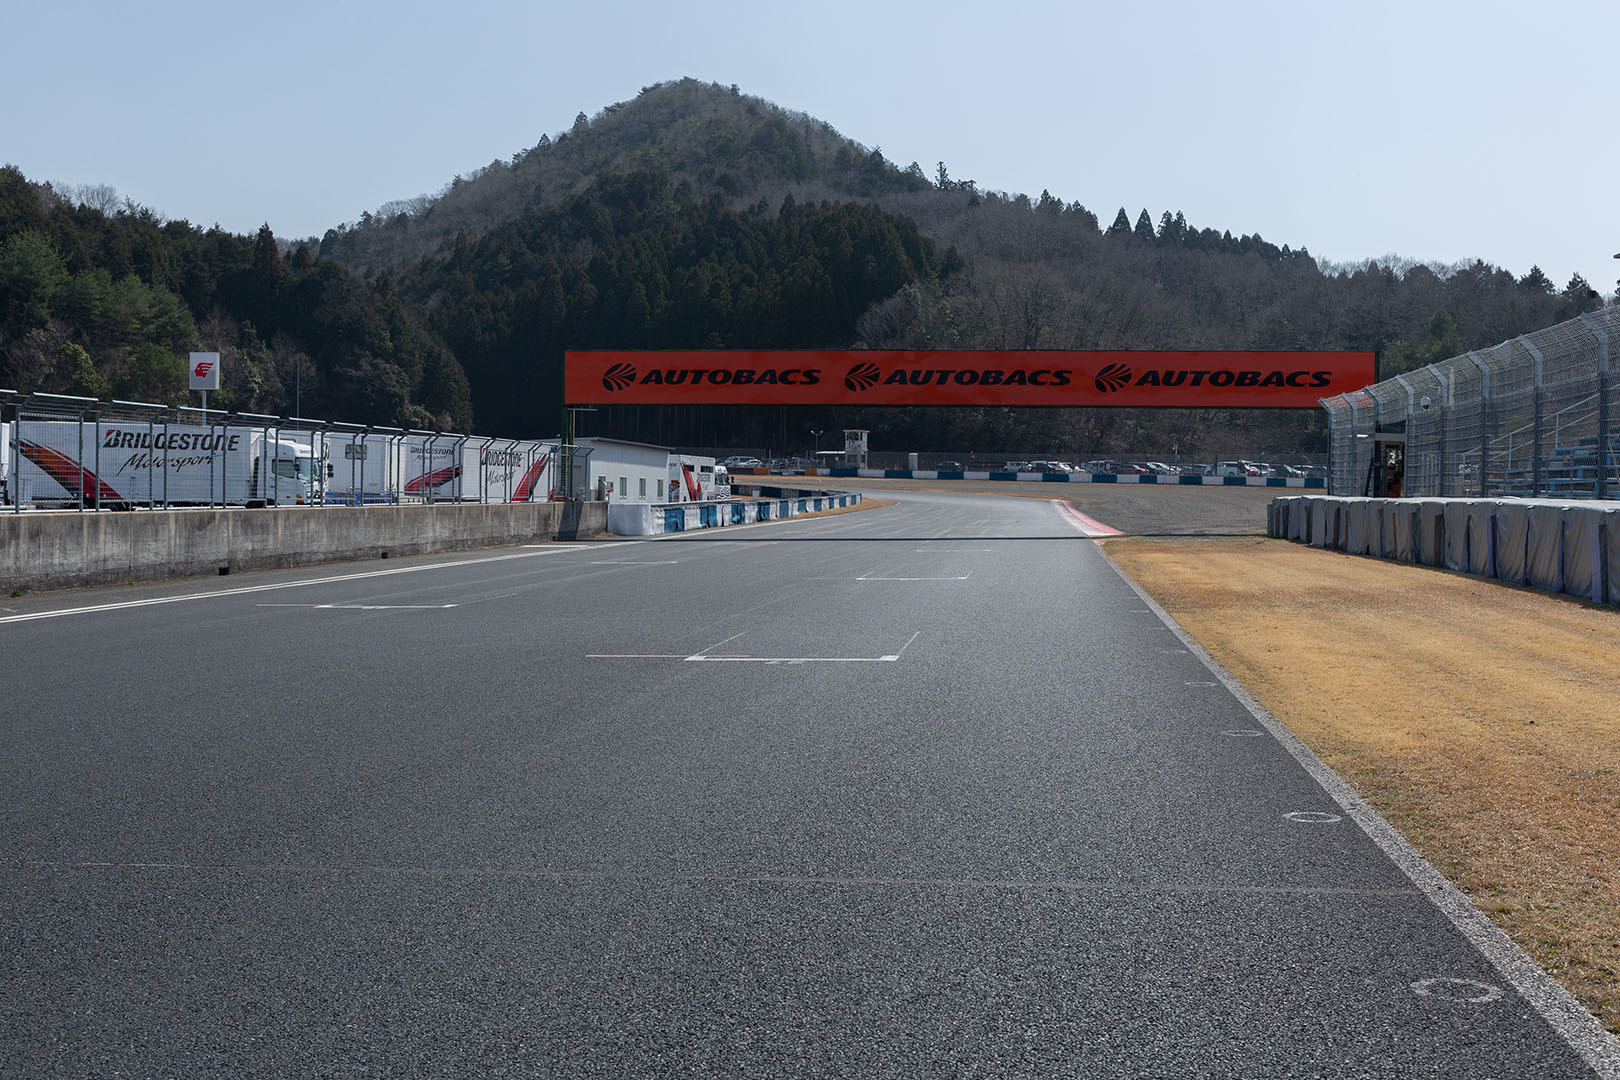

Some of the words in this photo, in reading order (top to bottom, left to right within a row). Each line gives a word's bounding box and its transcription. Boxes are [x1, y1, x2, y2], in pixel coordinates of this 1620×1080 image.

[638, 369, 822, 385] AUTOBACS
[882, 369, 1073, 386] AUTOBACS
[1134, 370, 1333, 388] AUTOBACS
[103, 429, 240, 451] BRIDGESTONE
